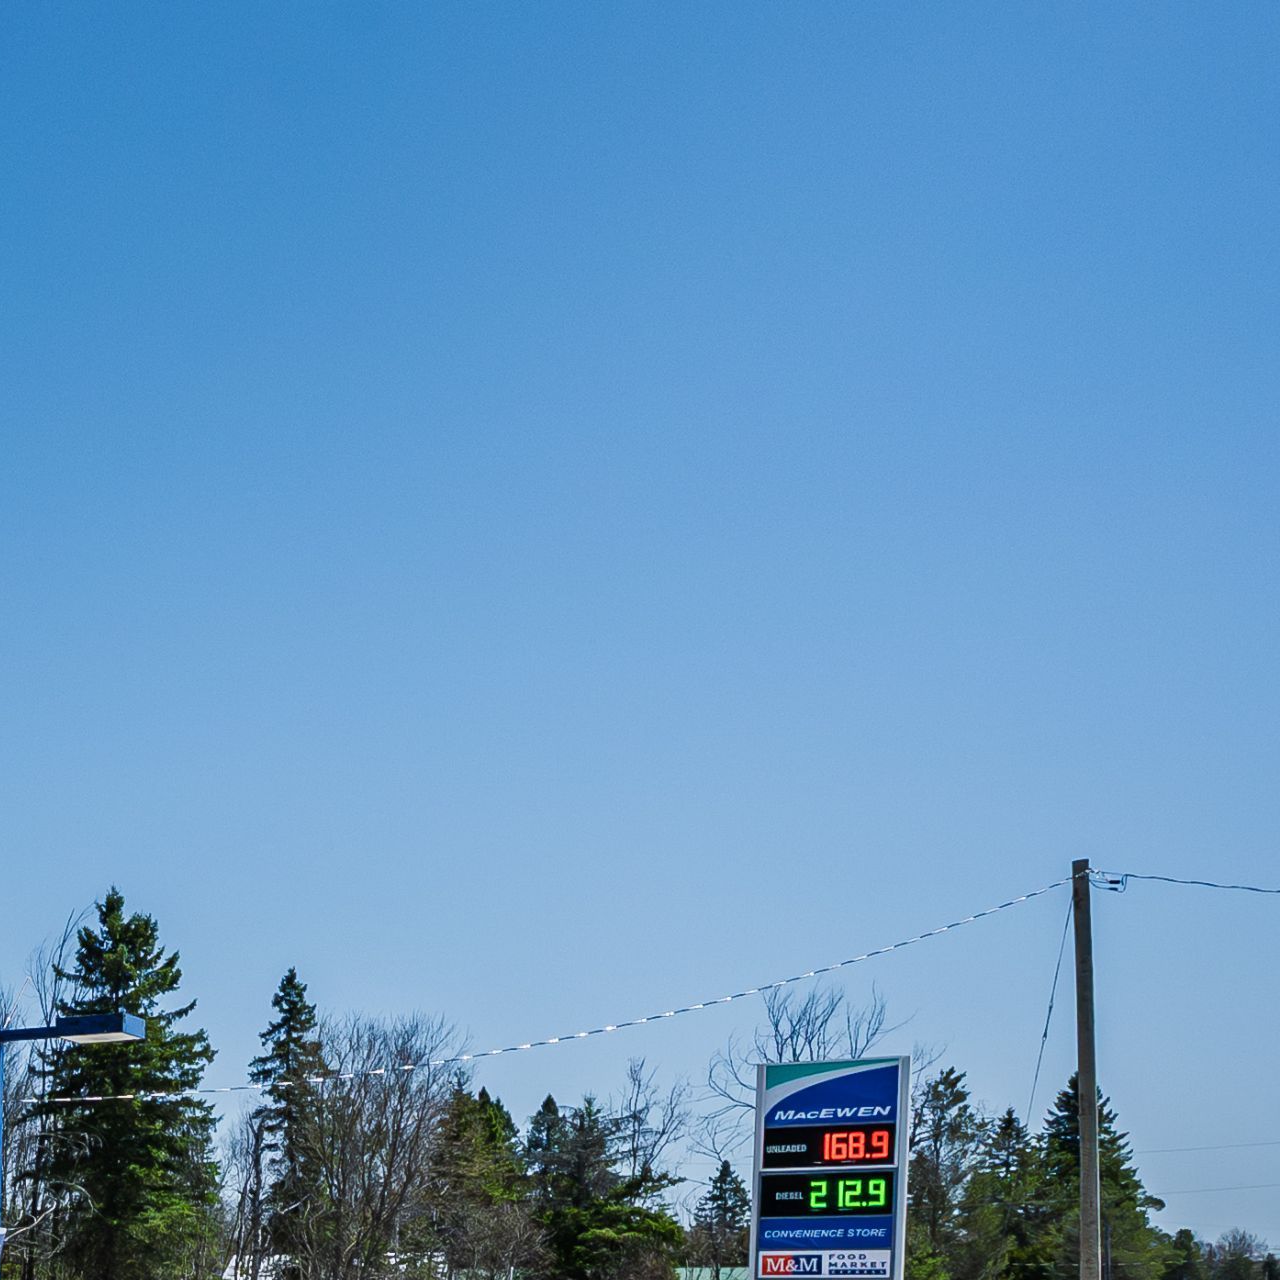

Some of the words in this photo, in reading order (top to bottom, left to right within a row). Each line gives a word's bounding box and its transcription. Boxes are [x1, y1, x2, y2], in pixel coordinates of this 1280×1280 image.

[766, 1144, 807, 1154] UNLEADED
[823, 1130, 889, 1161] 168.9
[775, 1191, 804, 1201] DIESEL
[810, 1179, 886, 1208] 212.9
[764, 1228, 845, 1239] CONVENIENCE
[847, 1228, 887, 1238] STORE
[766, 1257, 819, 1273] M&M
[828, 1253, 867, 1261] FOOD
